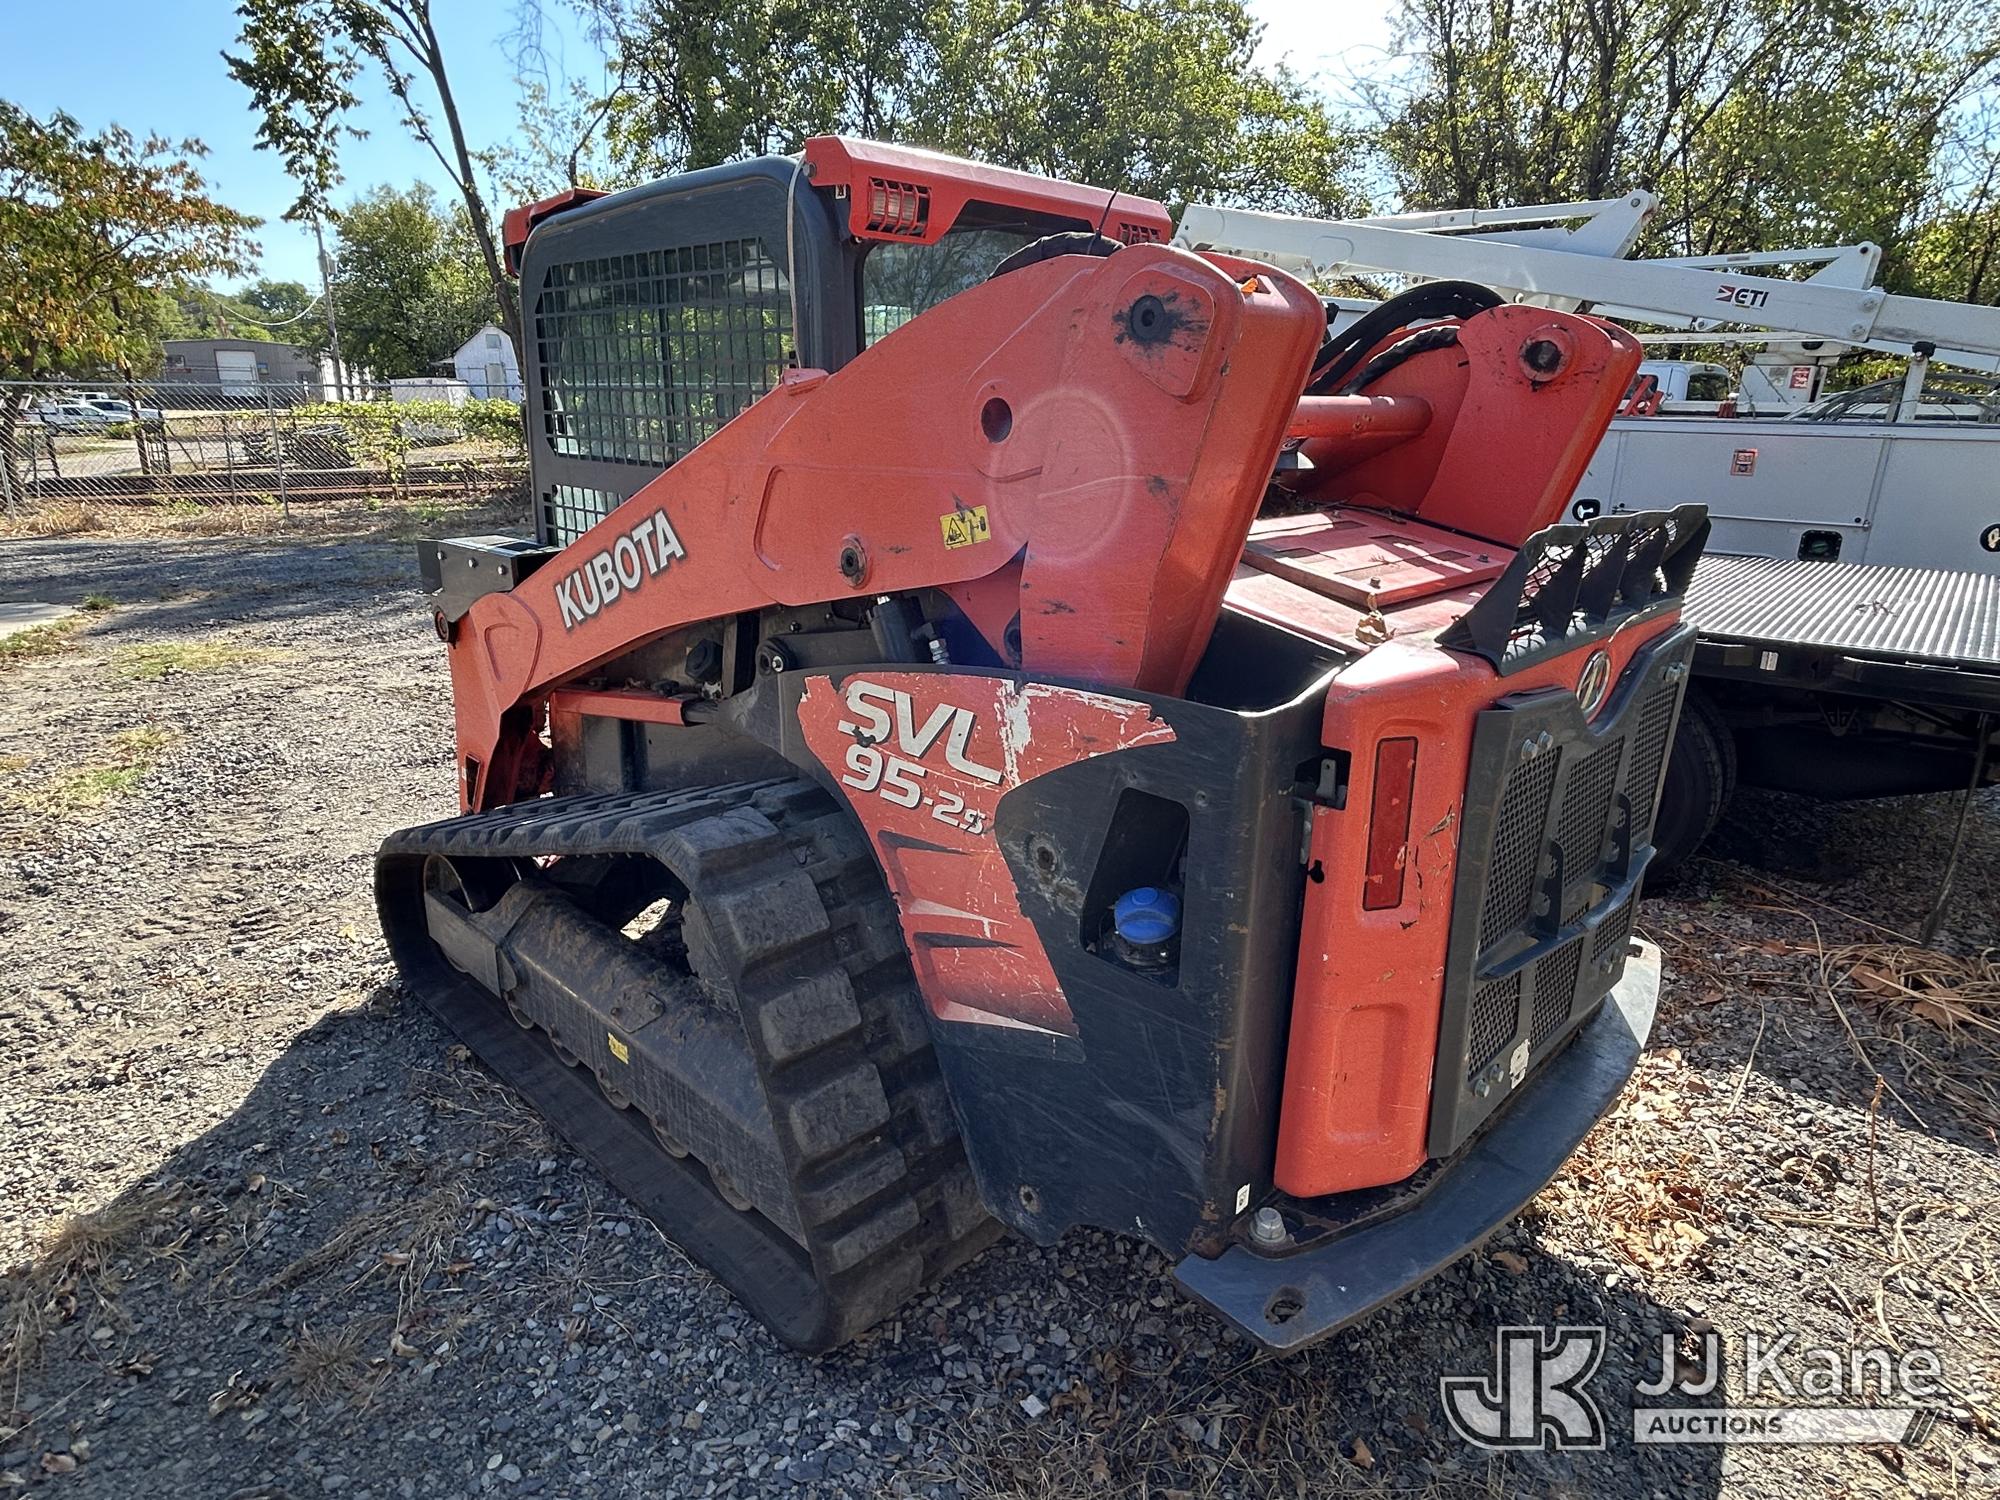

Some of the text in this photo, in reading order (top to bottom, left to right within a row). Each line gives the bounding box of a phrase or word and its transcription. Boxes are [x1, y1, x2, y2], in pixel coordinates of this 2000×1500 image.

[1734, 288, 1769, 307] ETI
[554, 508, 685, 629] KUBOTA
[837, 680, 1004, 784] SVL
